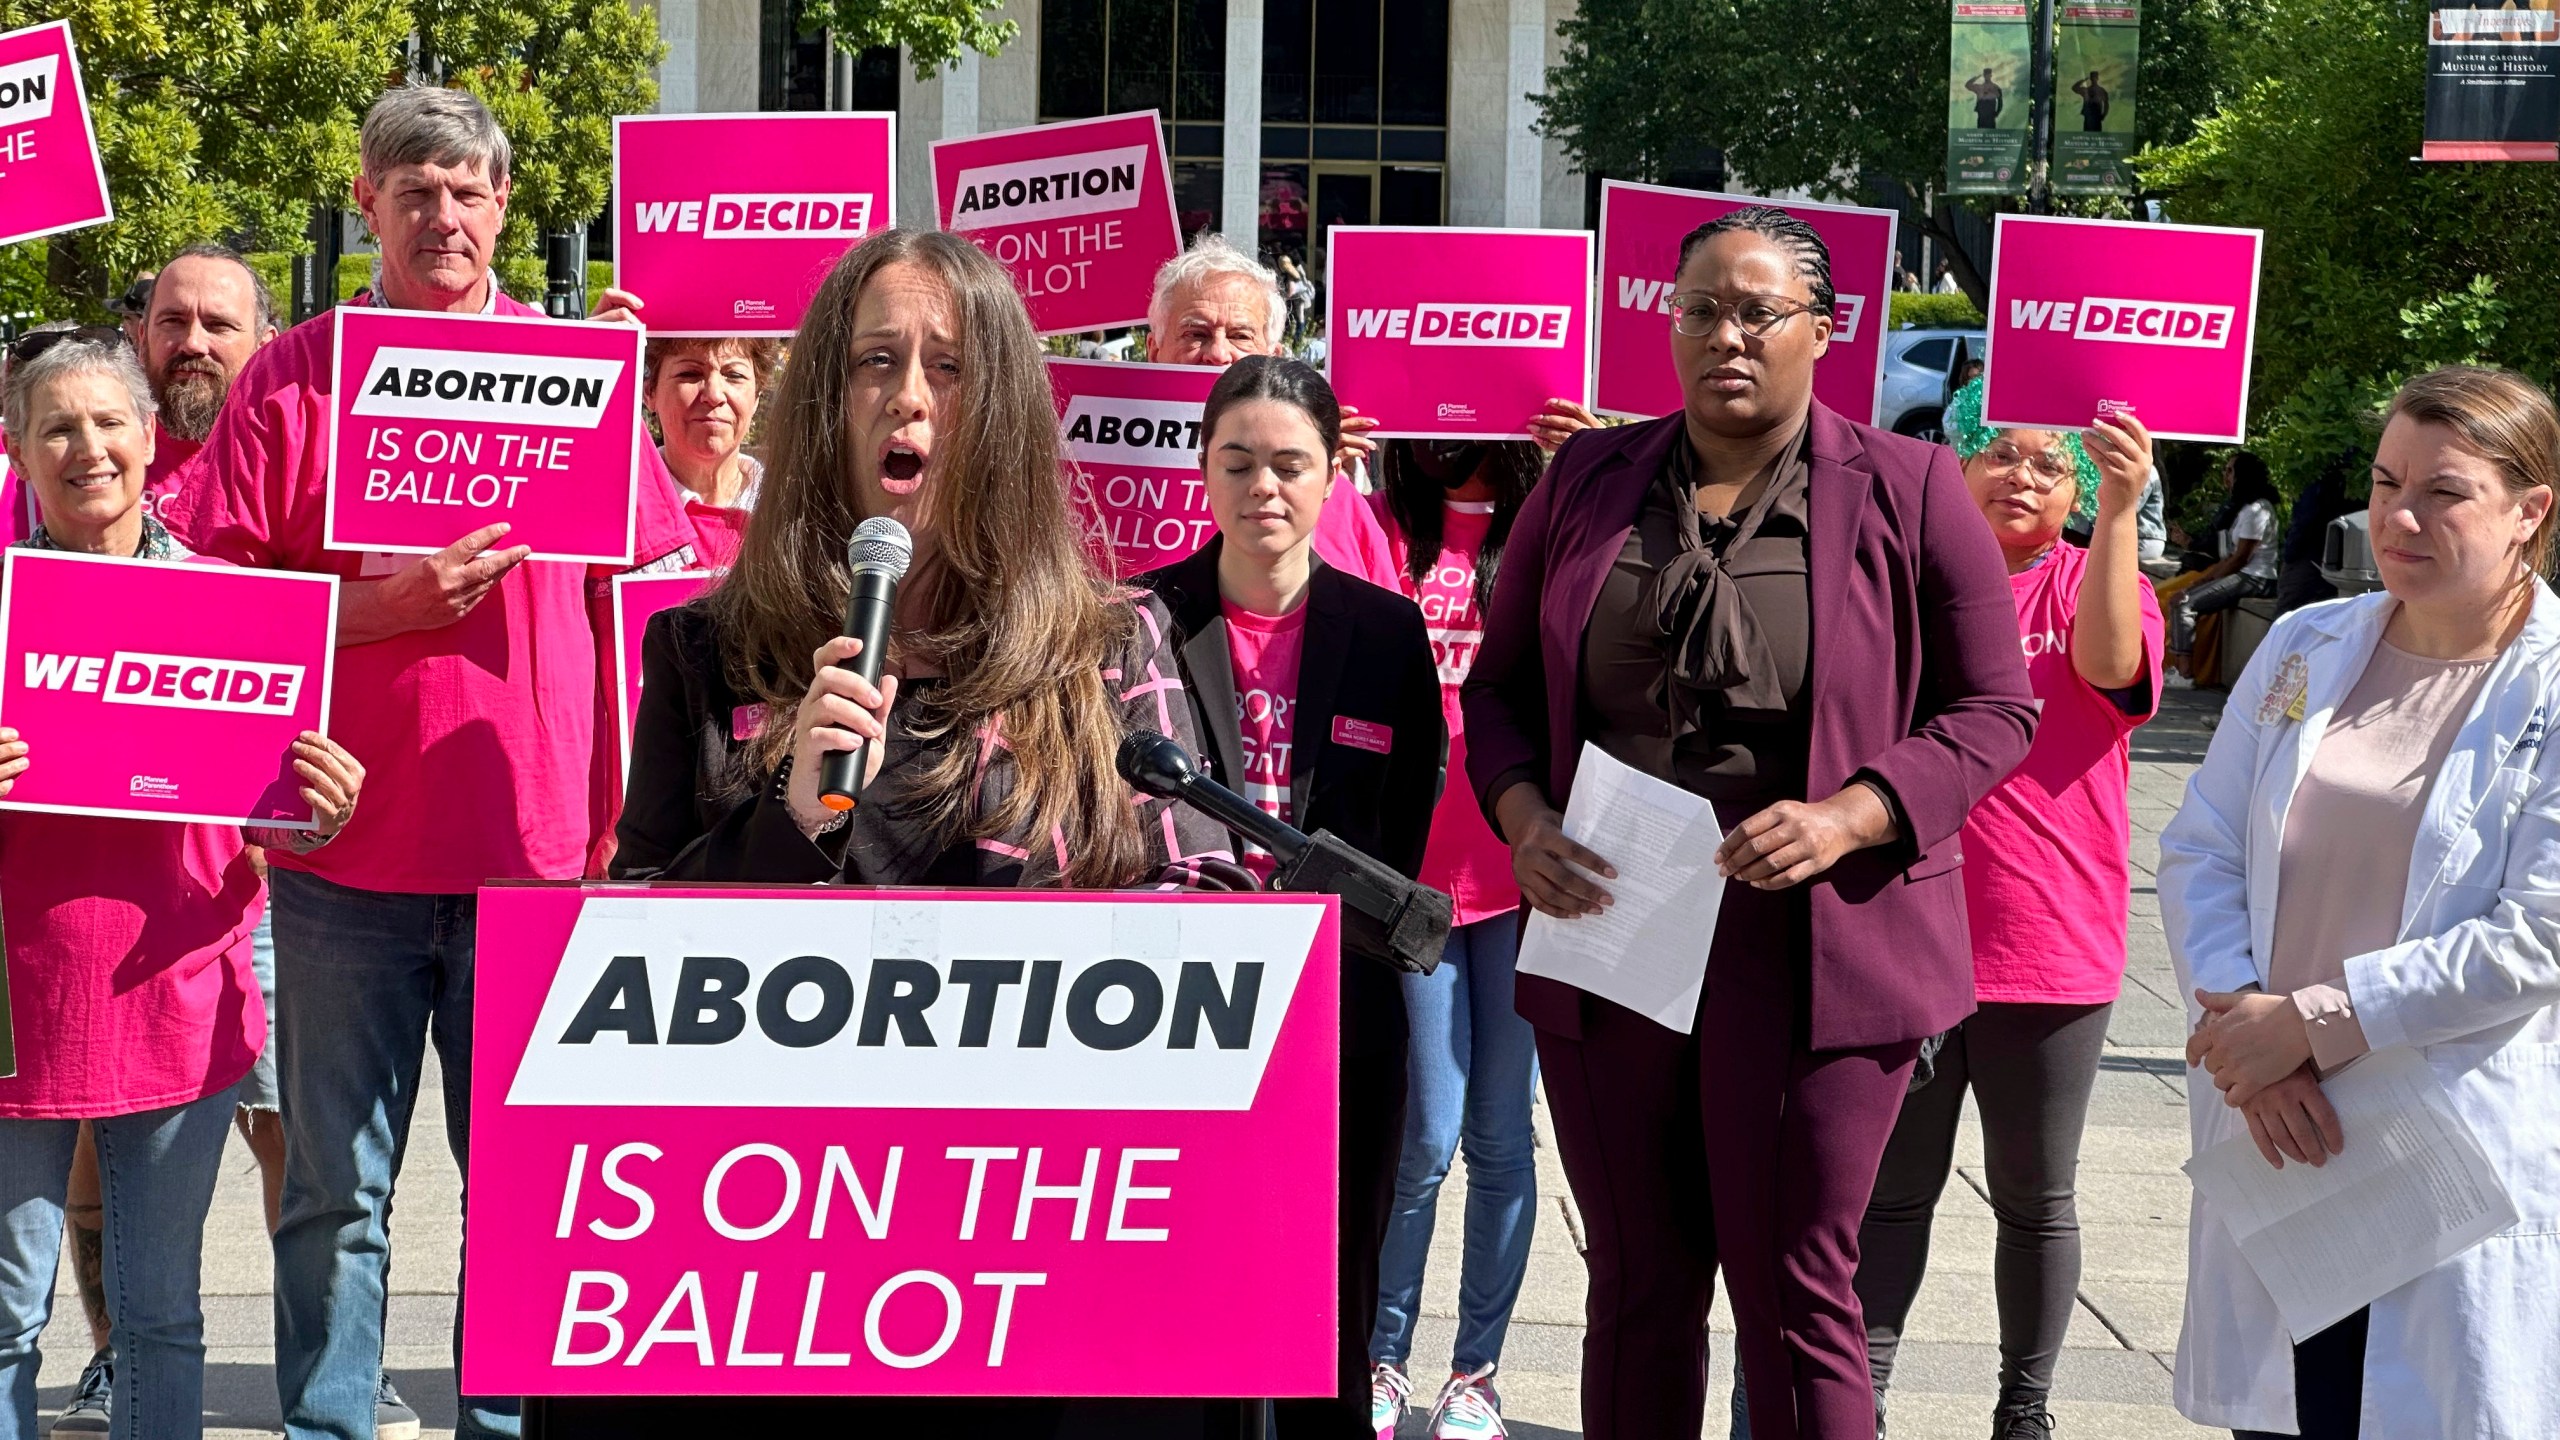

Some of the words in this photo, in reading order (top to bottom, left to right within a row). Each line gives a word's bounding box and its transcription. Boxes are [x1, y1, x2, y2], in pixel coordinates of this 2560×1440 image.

[2441, 61, 2485, 72] MUSEUM
[2503, 61, 2548, 72] HISTORY
[0, 74, 46, 109] ON
[0, 130, 37, 163] HE
[958, 163, 1135, 214] ABORTION
[635, 201, 702, 234] WE
[713, 200, 865, 232] DECIDE
[995, 230, 1047, 265] ON
[1057, 220, 1123, 256] THE
[1027, 260, 1093, 297] LOT
[1347, 308, 1411, 339] WE
[1419, 310, 1563, 341] DECIDE
[2011, 299, 2075, 332] WE
[2084, 305, 2227, 341] DECIDE
[369, 366, 604, 408] ABORTION
[366, 427, 403, 461] IS
[414, 430, 483, 464] ON
[496, 434, 574, 471] THE
[1067, 414, 1202, 450] ABORT
[364, 468, 529, 509] BALLOT
[1105, 475, 1169, 508] ON
[2021, 629, 2067, 657] ON
[24, 652, 106, 693] WE
[115, 661, 295, 707] DECIDE
[557, 955, 1266, 1051] ABORTION
[554, 1142, 664, 1242] IS
[702, 1142, 904, 1242] ON
[945, 1146, 1181, 1242] THE
[550, 1268, 1048, 1369] BALLOT
